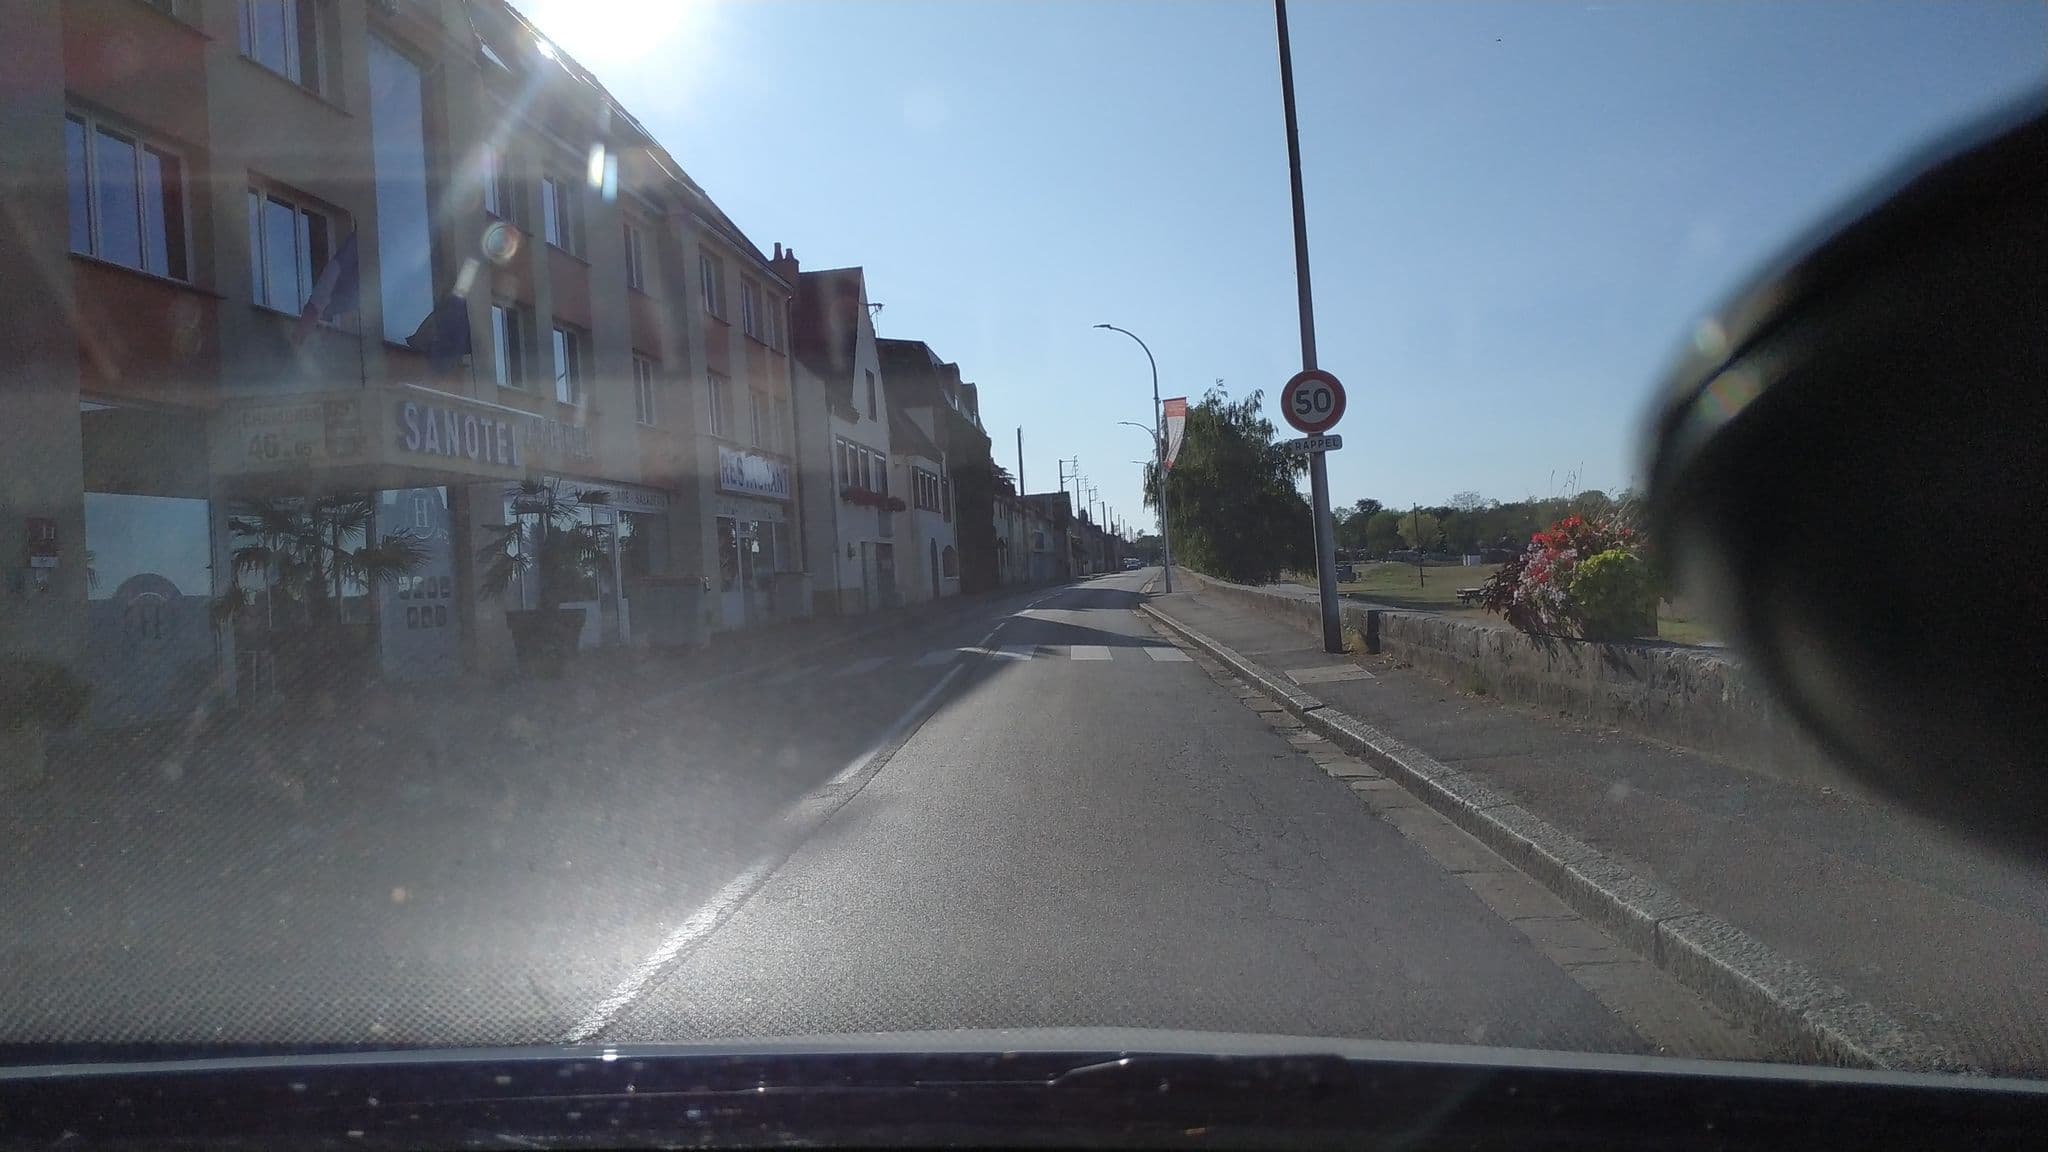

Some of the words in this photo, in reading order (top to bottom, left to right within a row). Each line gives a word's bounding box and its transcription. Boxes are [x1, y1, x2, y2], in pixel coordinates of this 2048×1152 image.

[1296, 389, 1331, 415] 50
[1295, 438, 1339, 450] RAPPEL
[721, 453, 788, 494] RESANT
